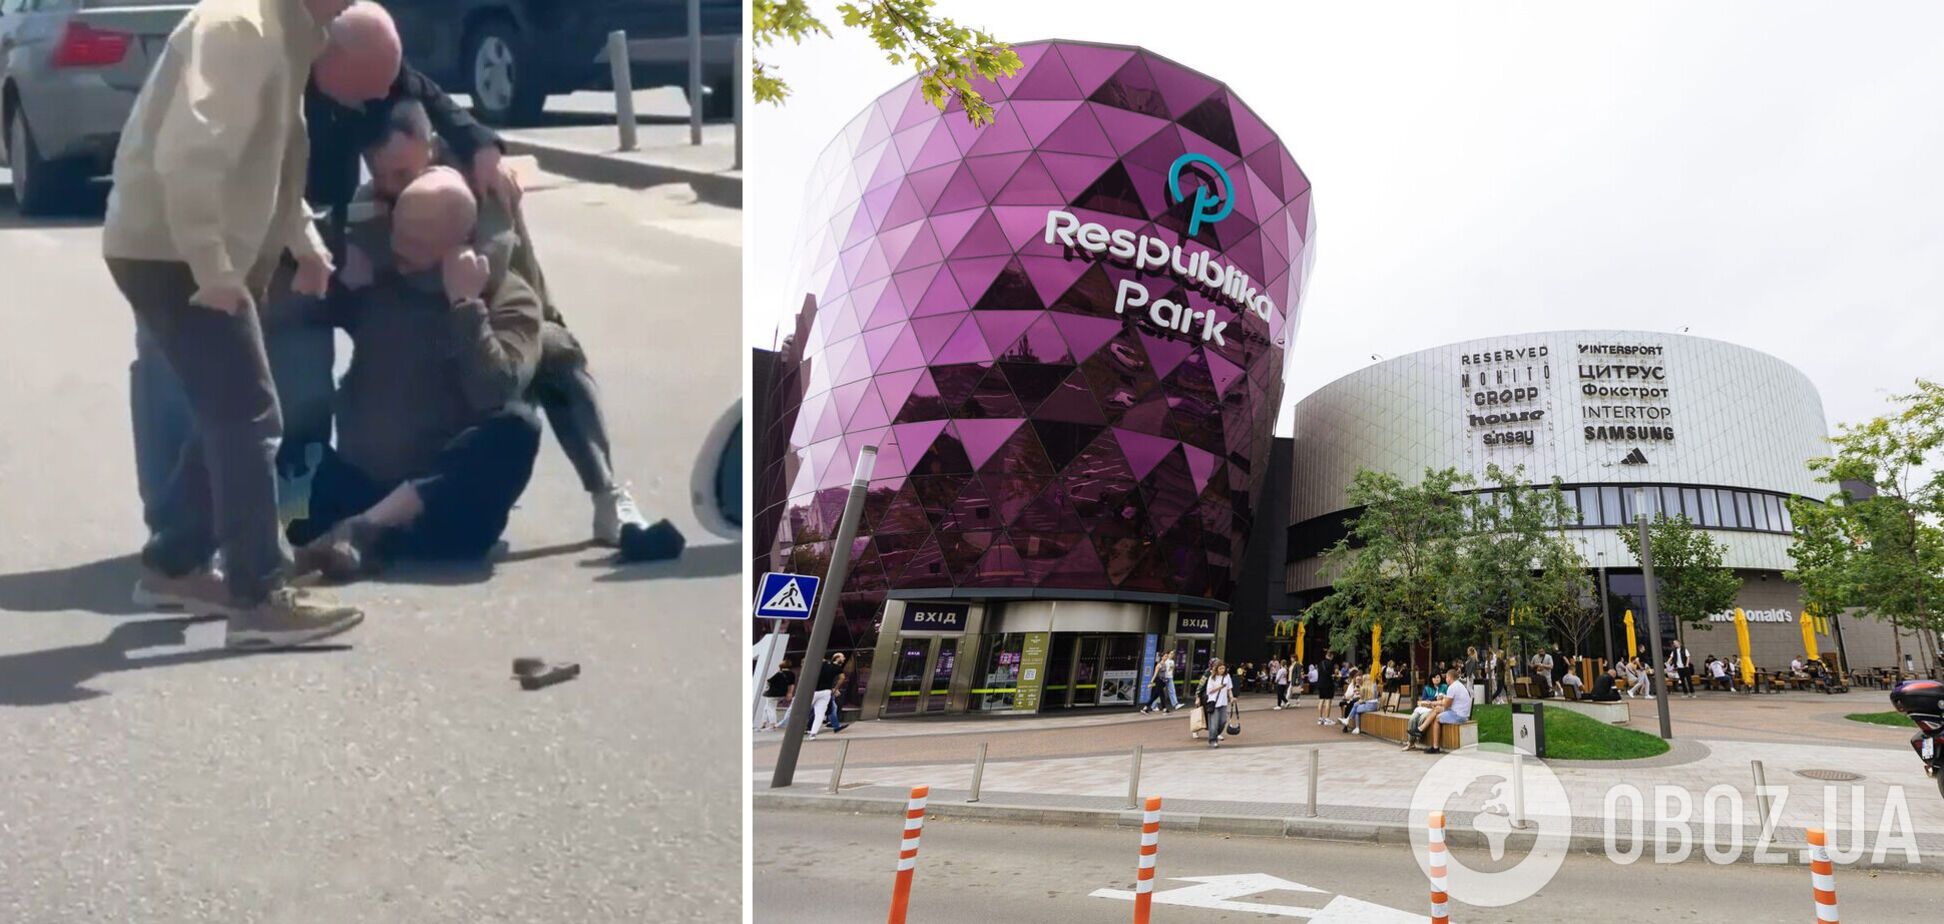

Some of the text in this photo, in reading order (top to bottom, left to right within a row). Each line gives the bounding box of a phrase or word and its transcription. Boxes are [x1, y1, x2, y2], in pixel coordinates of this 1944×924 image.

[1045, 210, 1273, 322] Respublika
[1114, 279, 1228, 346] Park
[1462, 346, 1548, 365] RESERVED
[1590, 345, 1663, 355] INTERSPORT
[1462, 365, 1550, 388] MOHITO
[1578, 365, 1665, 380] ЦИТРУС
[1474, 387, 1538, 406] CROPP
[1582, 383, 1669, 399] Фокстрот
[1469, 410, 1545, 426] house
[1582, 406, 1671, 420] INTERTOP
[1483, 430, 1534, 445] sinsay
[1584, 426, 1674, 441] SAMSUNG
[914, 611, 957, 625] ВХІД
[1182, 618, 1209, 629] ВХІД
